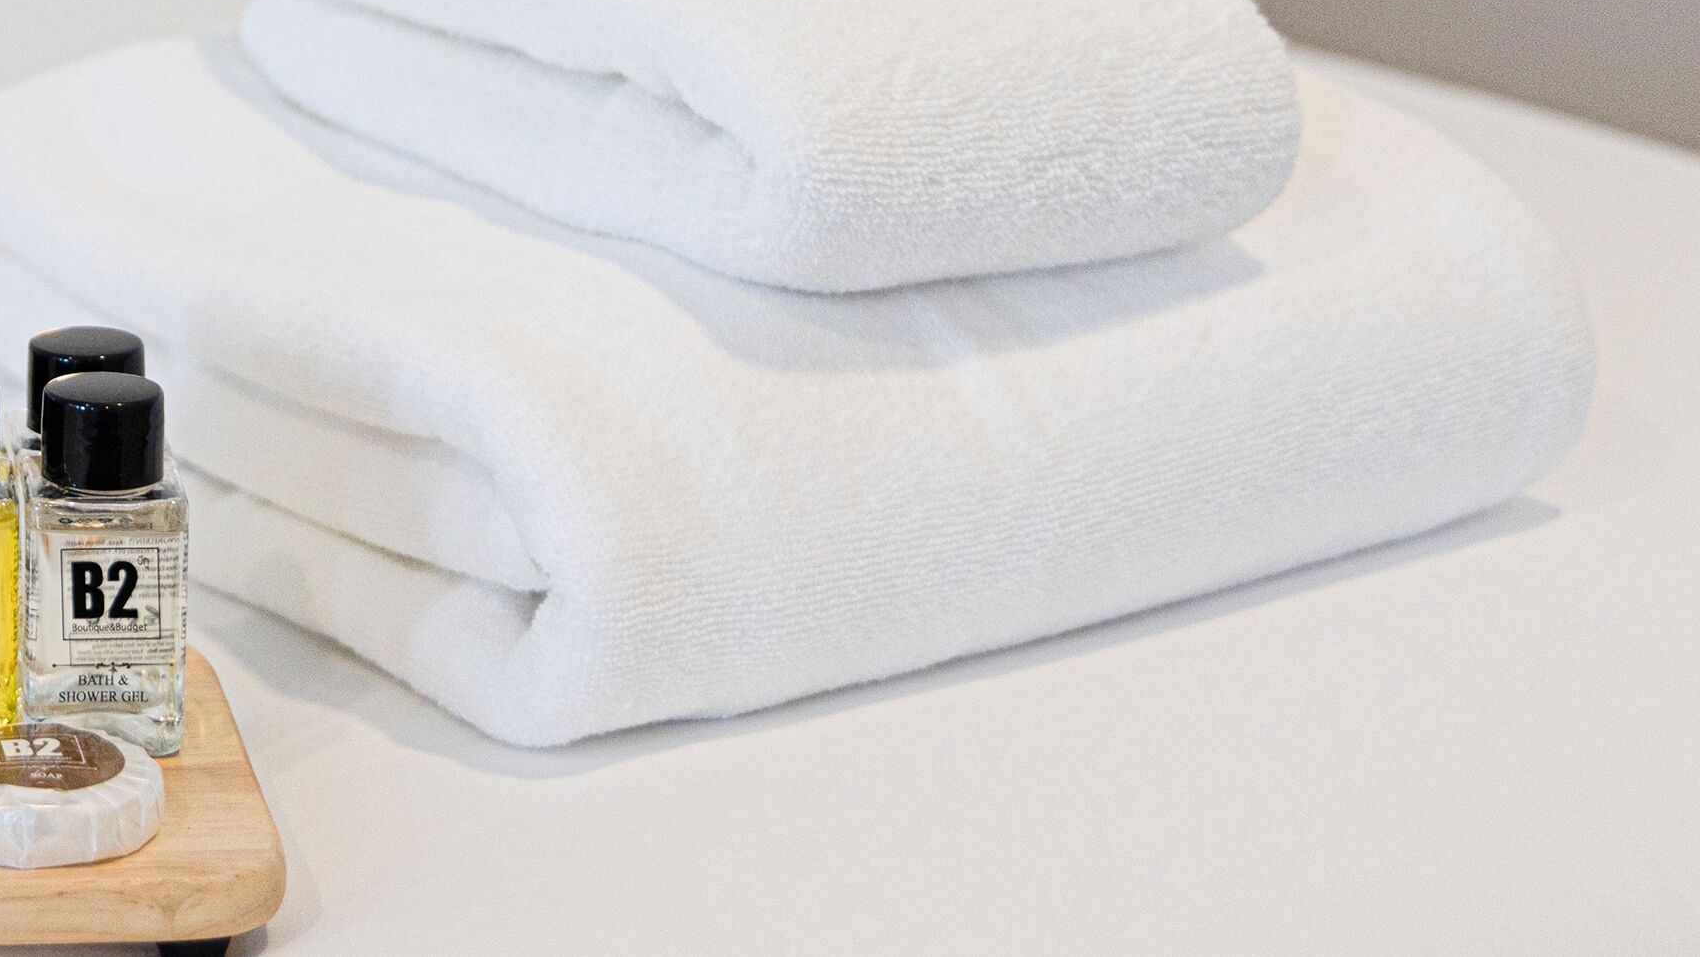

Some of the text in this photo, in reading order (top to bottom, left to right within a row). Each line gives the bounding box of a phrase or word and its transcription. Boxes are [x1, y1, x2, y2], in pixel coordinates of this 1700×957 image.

[70, 560, 139, 620] B2
[71, 622, 148, 634] Boutique&Budget
[78, 674, 129, 686] BATH &
[58, 690, 149, 703] SHOWER GEL
[0, 737, 64, 757] B2
